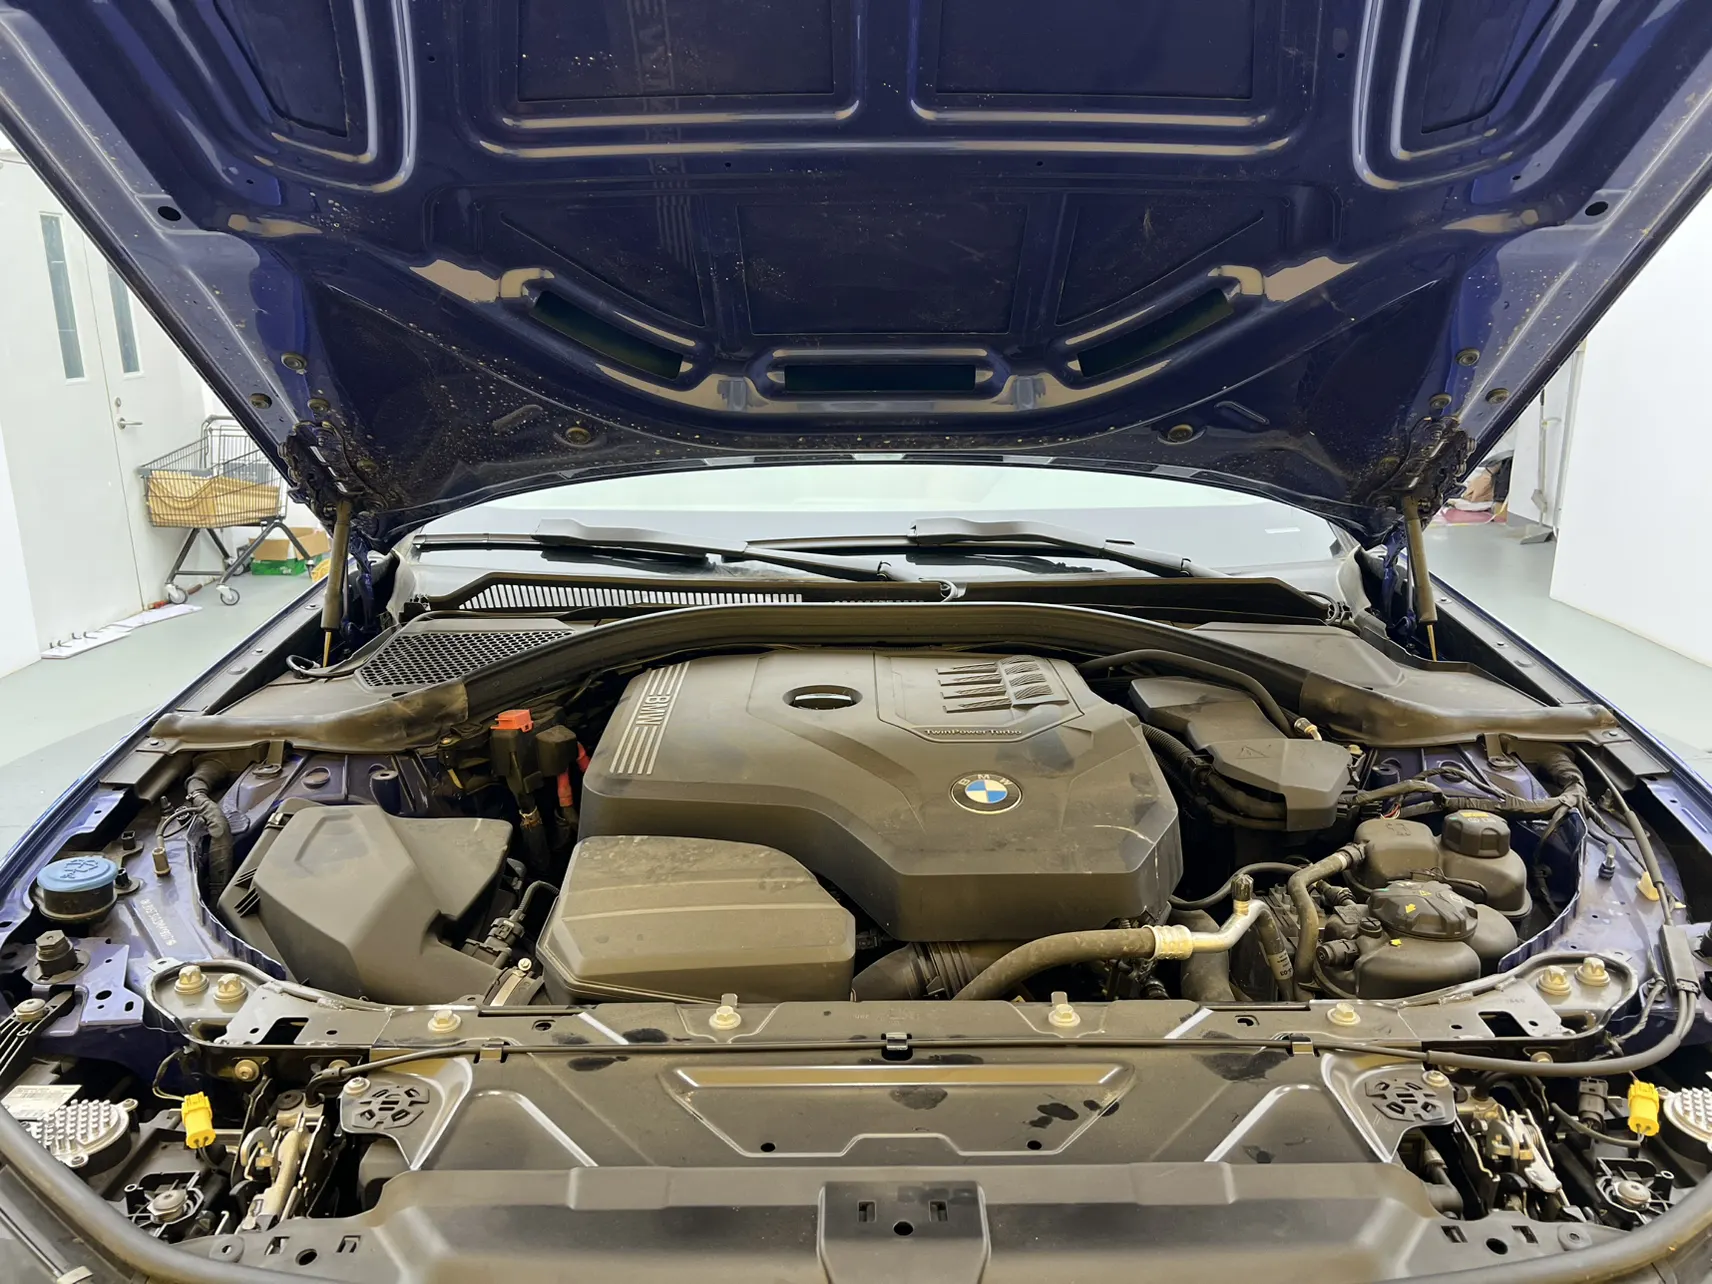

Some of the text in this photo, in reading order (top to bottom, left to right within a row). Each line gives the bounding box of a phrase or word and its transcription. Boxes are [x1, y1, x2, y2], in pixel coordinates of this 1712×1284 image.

[635, 695, 671, 725] BMW
[925, 728, 1022, 736] TwinPower Turbo
[957, 773, 1014, 786] BMW
